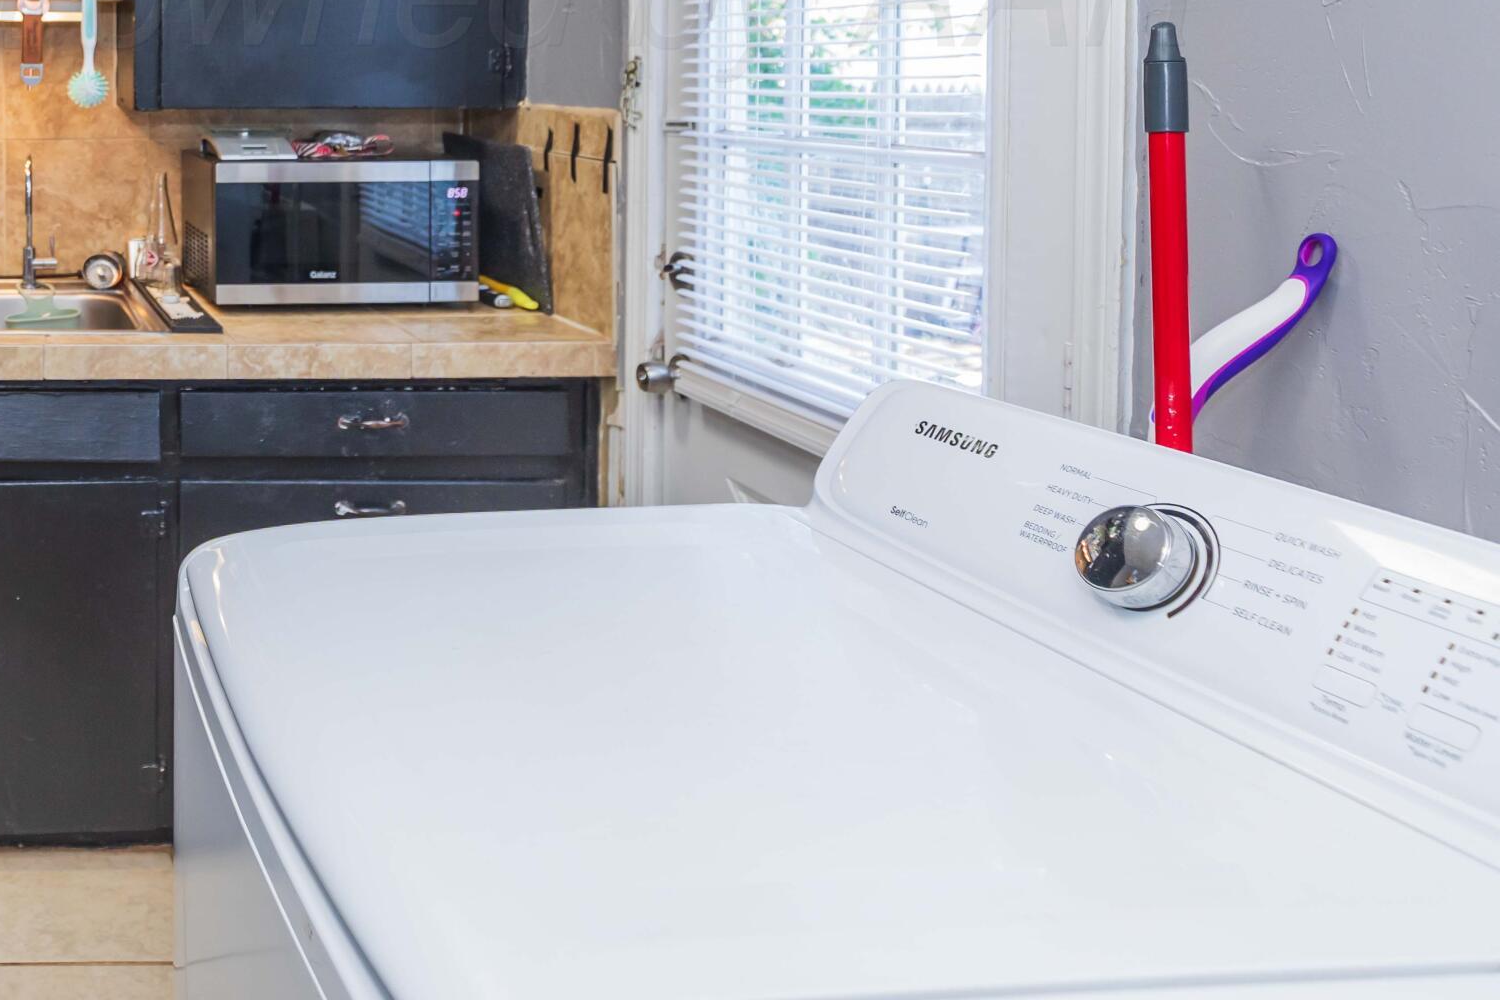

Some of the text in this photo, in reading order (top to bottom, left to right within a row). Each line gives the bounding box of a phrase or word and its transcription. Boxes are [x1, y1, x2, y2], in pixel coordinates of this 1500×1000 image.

[914, 420, 999, 459] SAMSUNG
[1059, 463, 1092, 480] NORMAL
[1046, 484, 1093, 504] HEAVY DUTY
[1032, 503, 1077, 525] DEEP WASH
[1023, 519, 1056, 539] BEDDING
[1019, 529, 1068, 553] WATERPROOF
[1243, 579, 1274, 599] RINSE
[1281, 594, 1308, 611] SPIN
